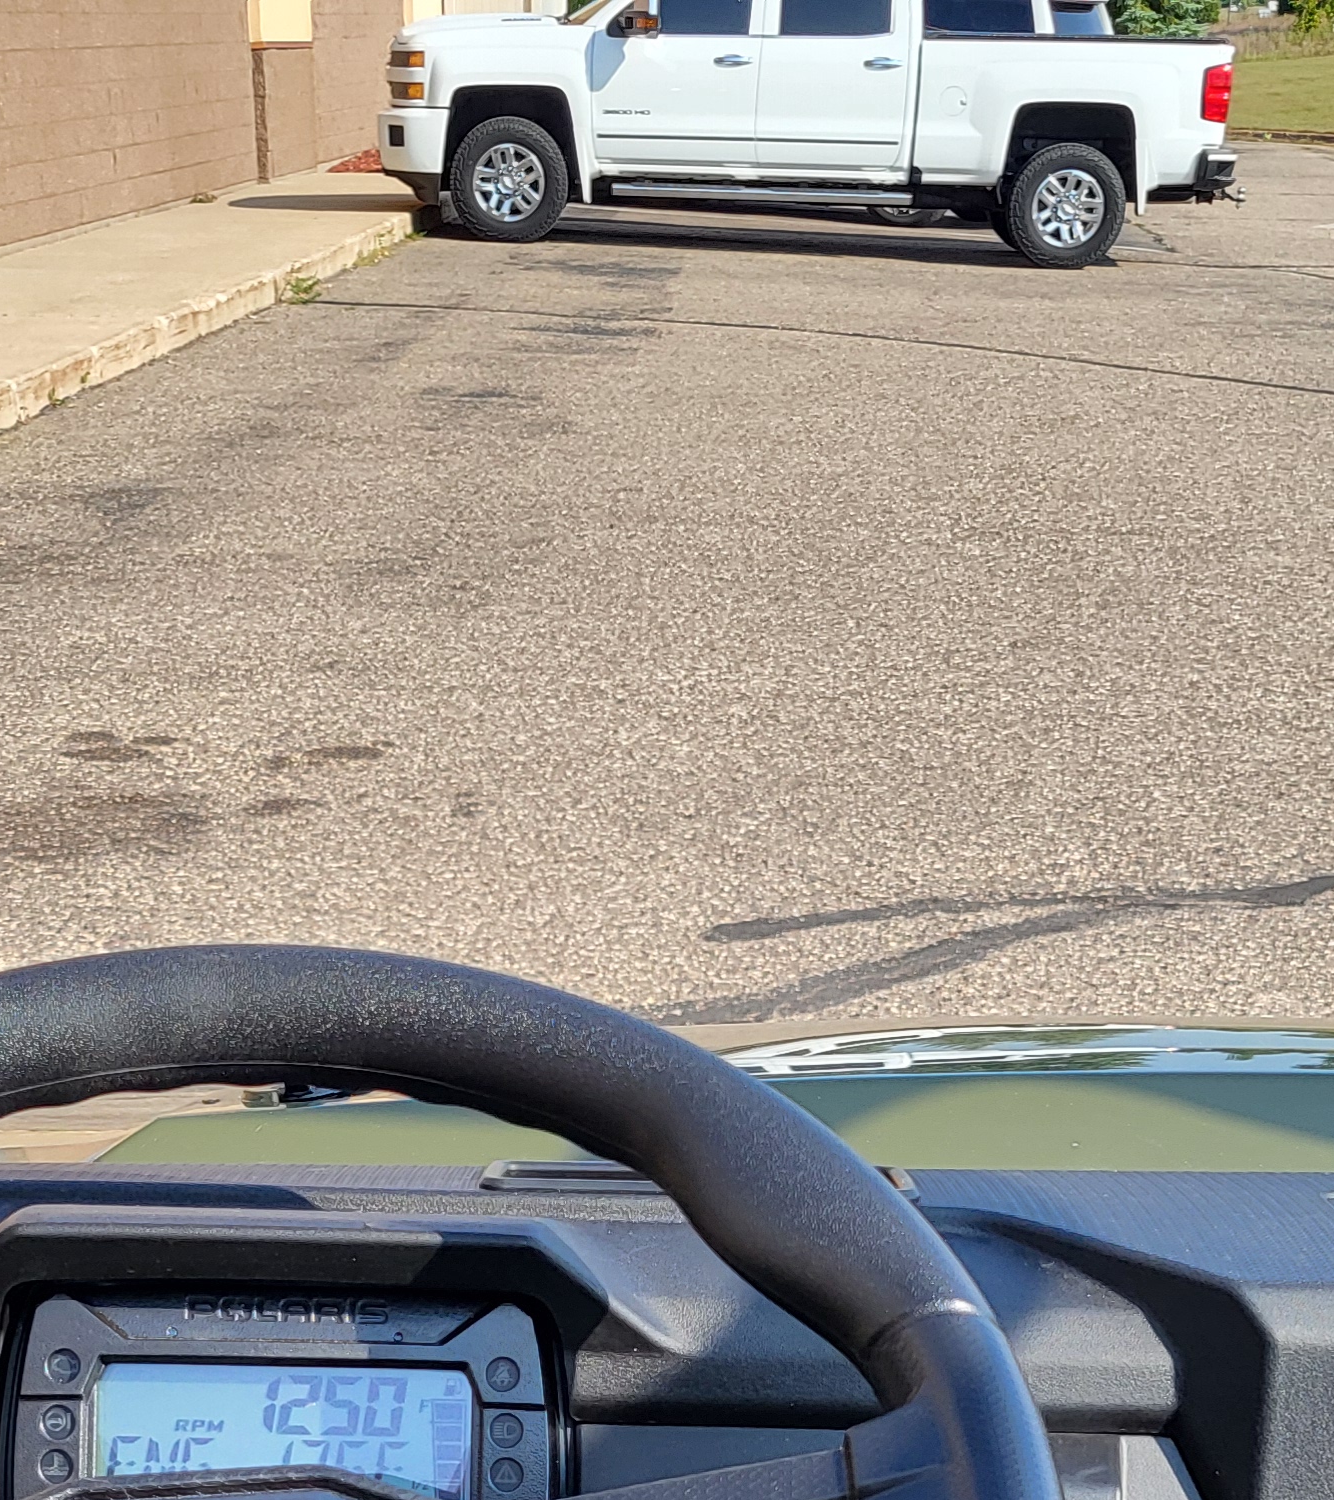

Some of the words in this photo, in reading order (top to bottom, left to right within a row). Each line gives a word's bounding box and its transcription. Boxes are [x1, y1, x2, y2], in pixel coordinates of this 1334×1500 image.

[183, 1296, 389, 1325] POLARIS
[262, 1375, 408, 1437] 1250
[174, 1418, 225, 1434] RPM
